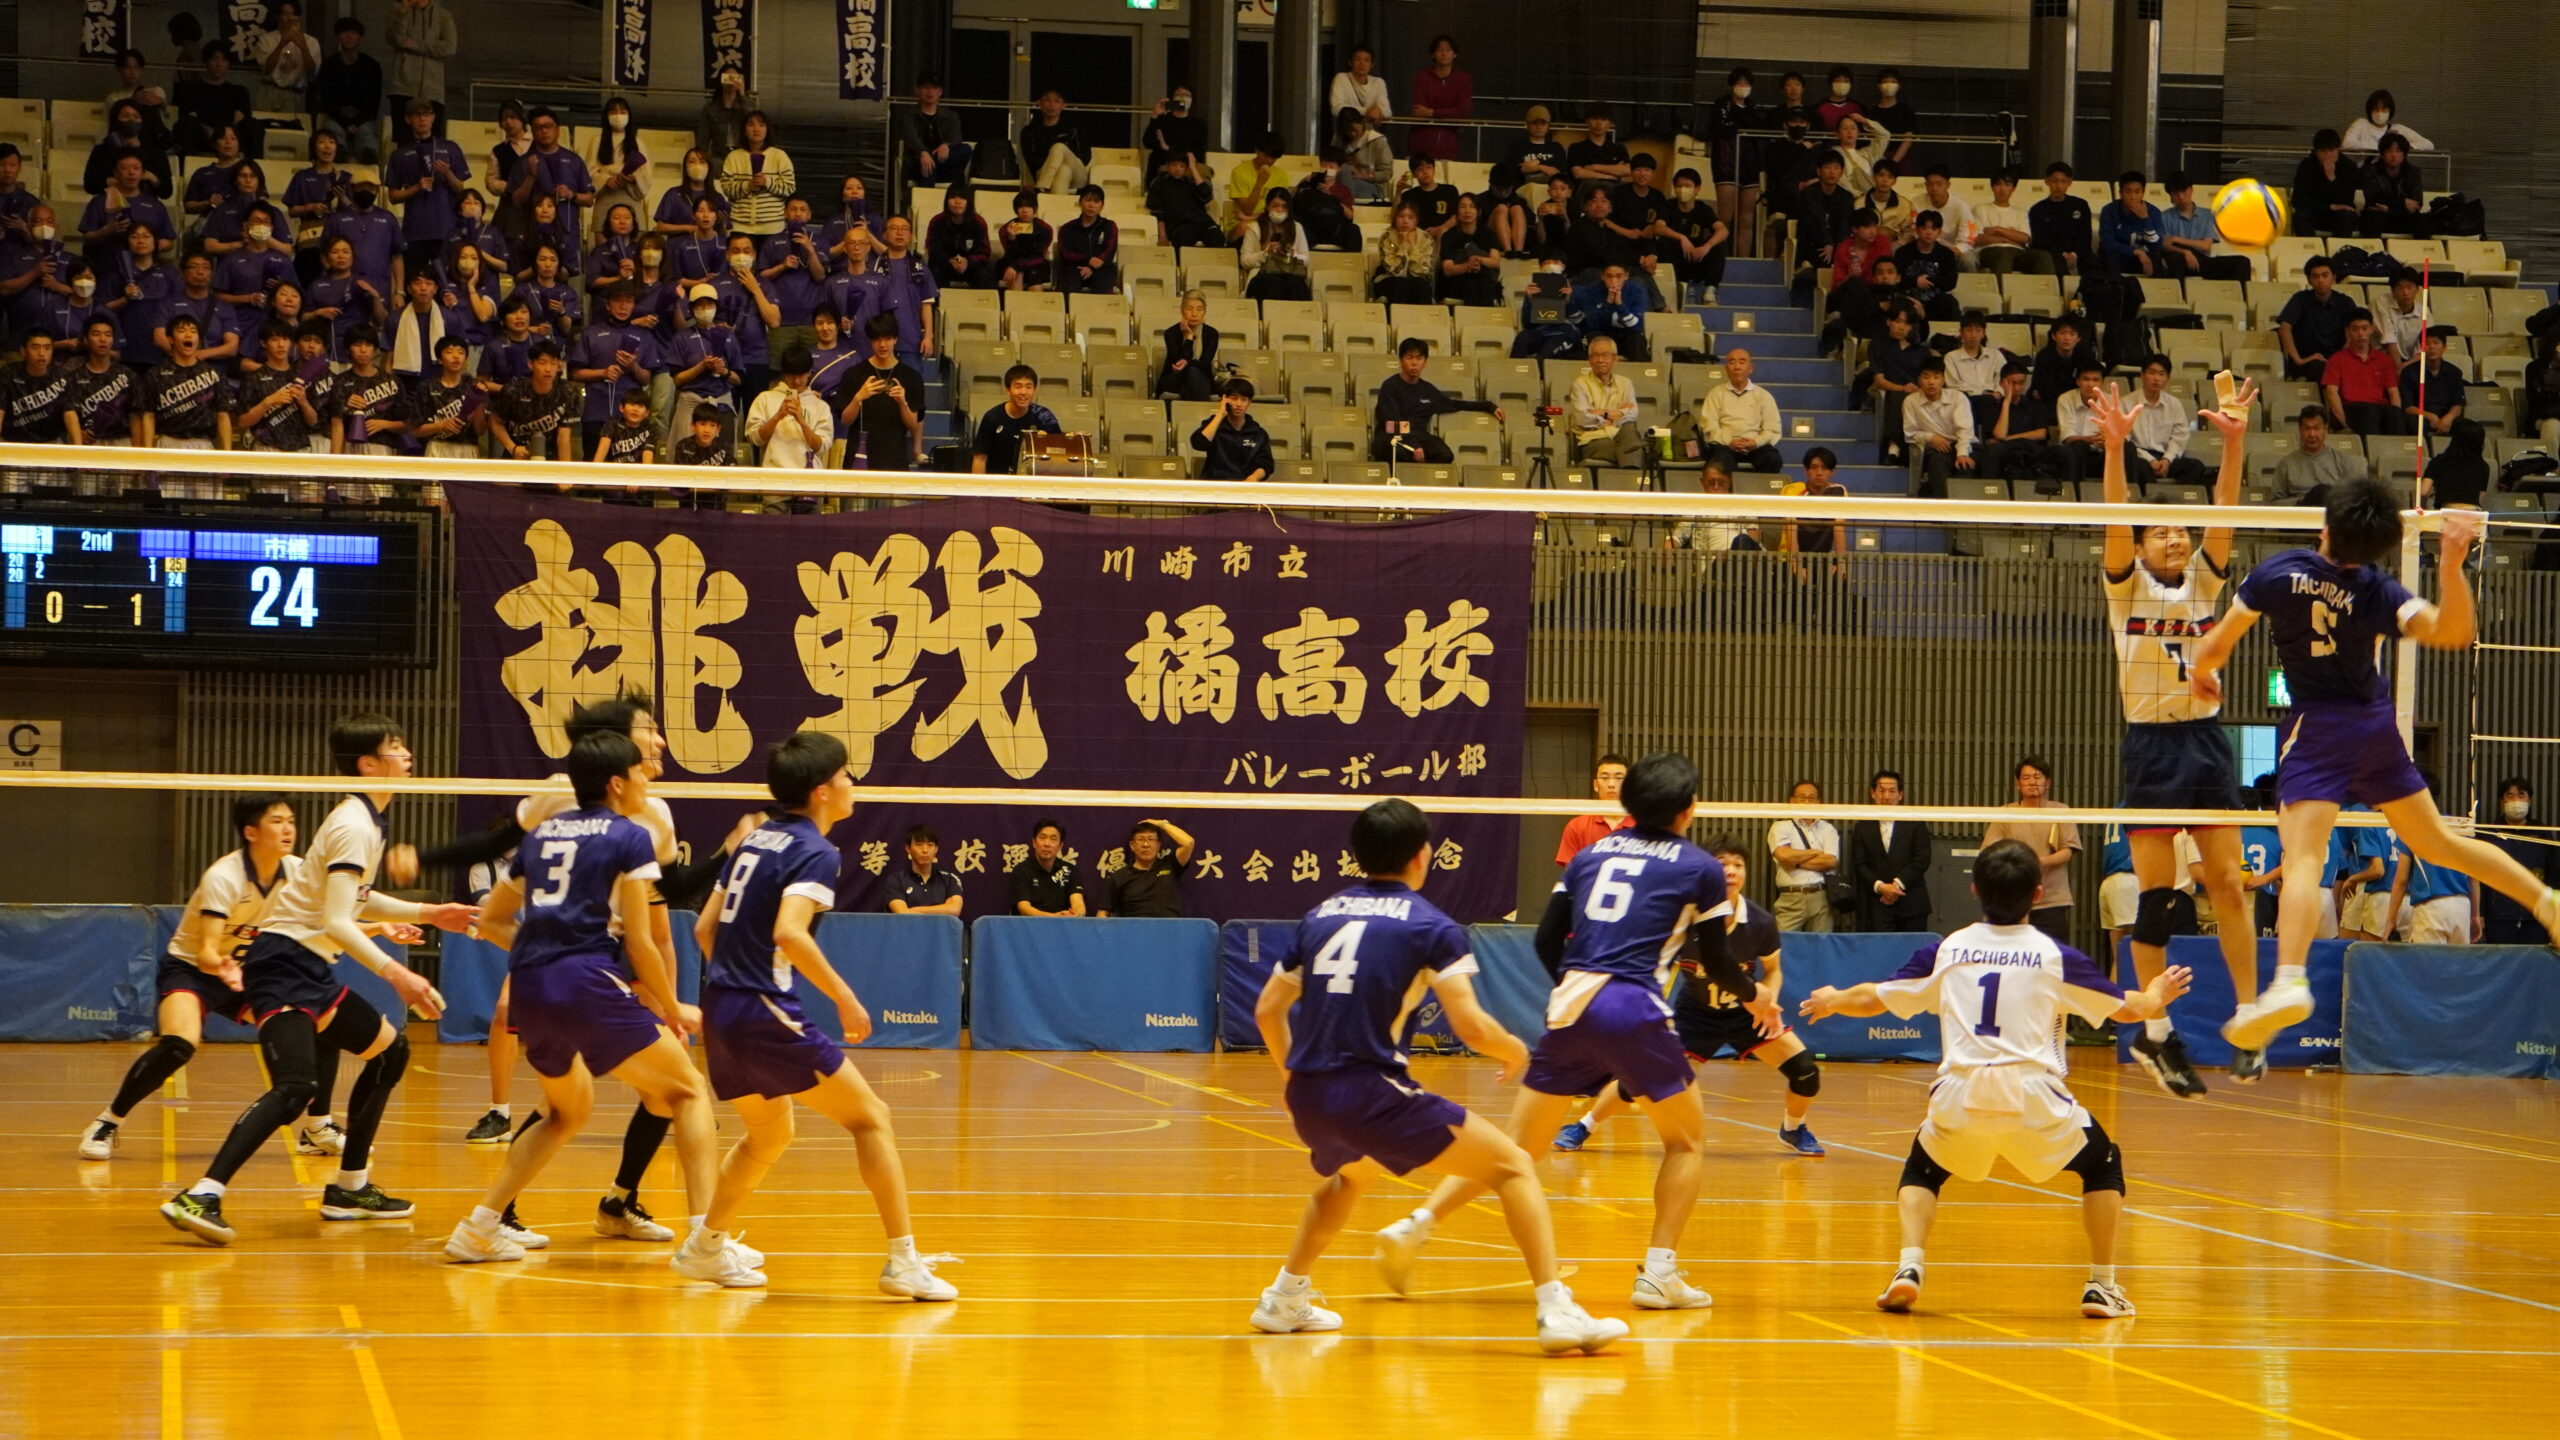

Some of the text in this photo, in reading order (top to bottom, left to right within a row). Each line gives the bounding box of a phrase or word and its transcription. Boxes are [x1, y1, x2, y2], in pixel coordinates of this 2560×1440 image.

[81, 531, 113, 552] 2nd
[8, 553, 24, 567] 20
[8, 567, 24, 583] 20
[35, 560, 45, 579] 2
[169, 558, 182, 571] 25
[1102, 541, 1309, 582] 川崎市立
[168, 572, 183, 587] 24
[251, 566, 319, 628] 24
[46, 591, 63, 623] 0
[130, 593, 142, 626] 1
[2311, 600, 2338, 657] 5
[495, 518, 1048, 780] 挑戦
[1125, 599, 1494, 724] 橘高校
[2165, 643, 2188, 682] 7
[8, 724, 41, 756] C
[1223, 744, 1487, 789] バレーボール部
[531, 840, 579, 907] 3
[719, 852, 761, 923] 8
[1584, 856, 1648, 923] 6
[1312, 920, 1368, 994] 4
[1951, 947, 2043, 969] TACHIBANA
[67, 1005, 118, 1021] Nittak
[883, 1009, 939, 1025] Nittaku
[1145, 1012, 1199, 1028] Nittaku
[1974, 972, 2002, 1037] 1
[1868, 1025, 1922, 1041] Nittaku
